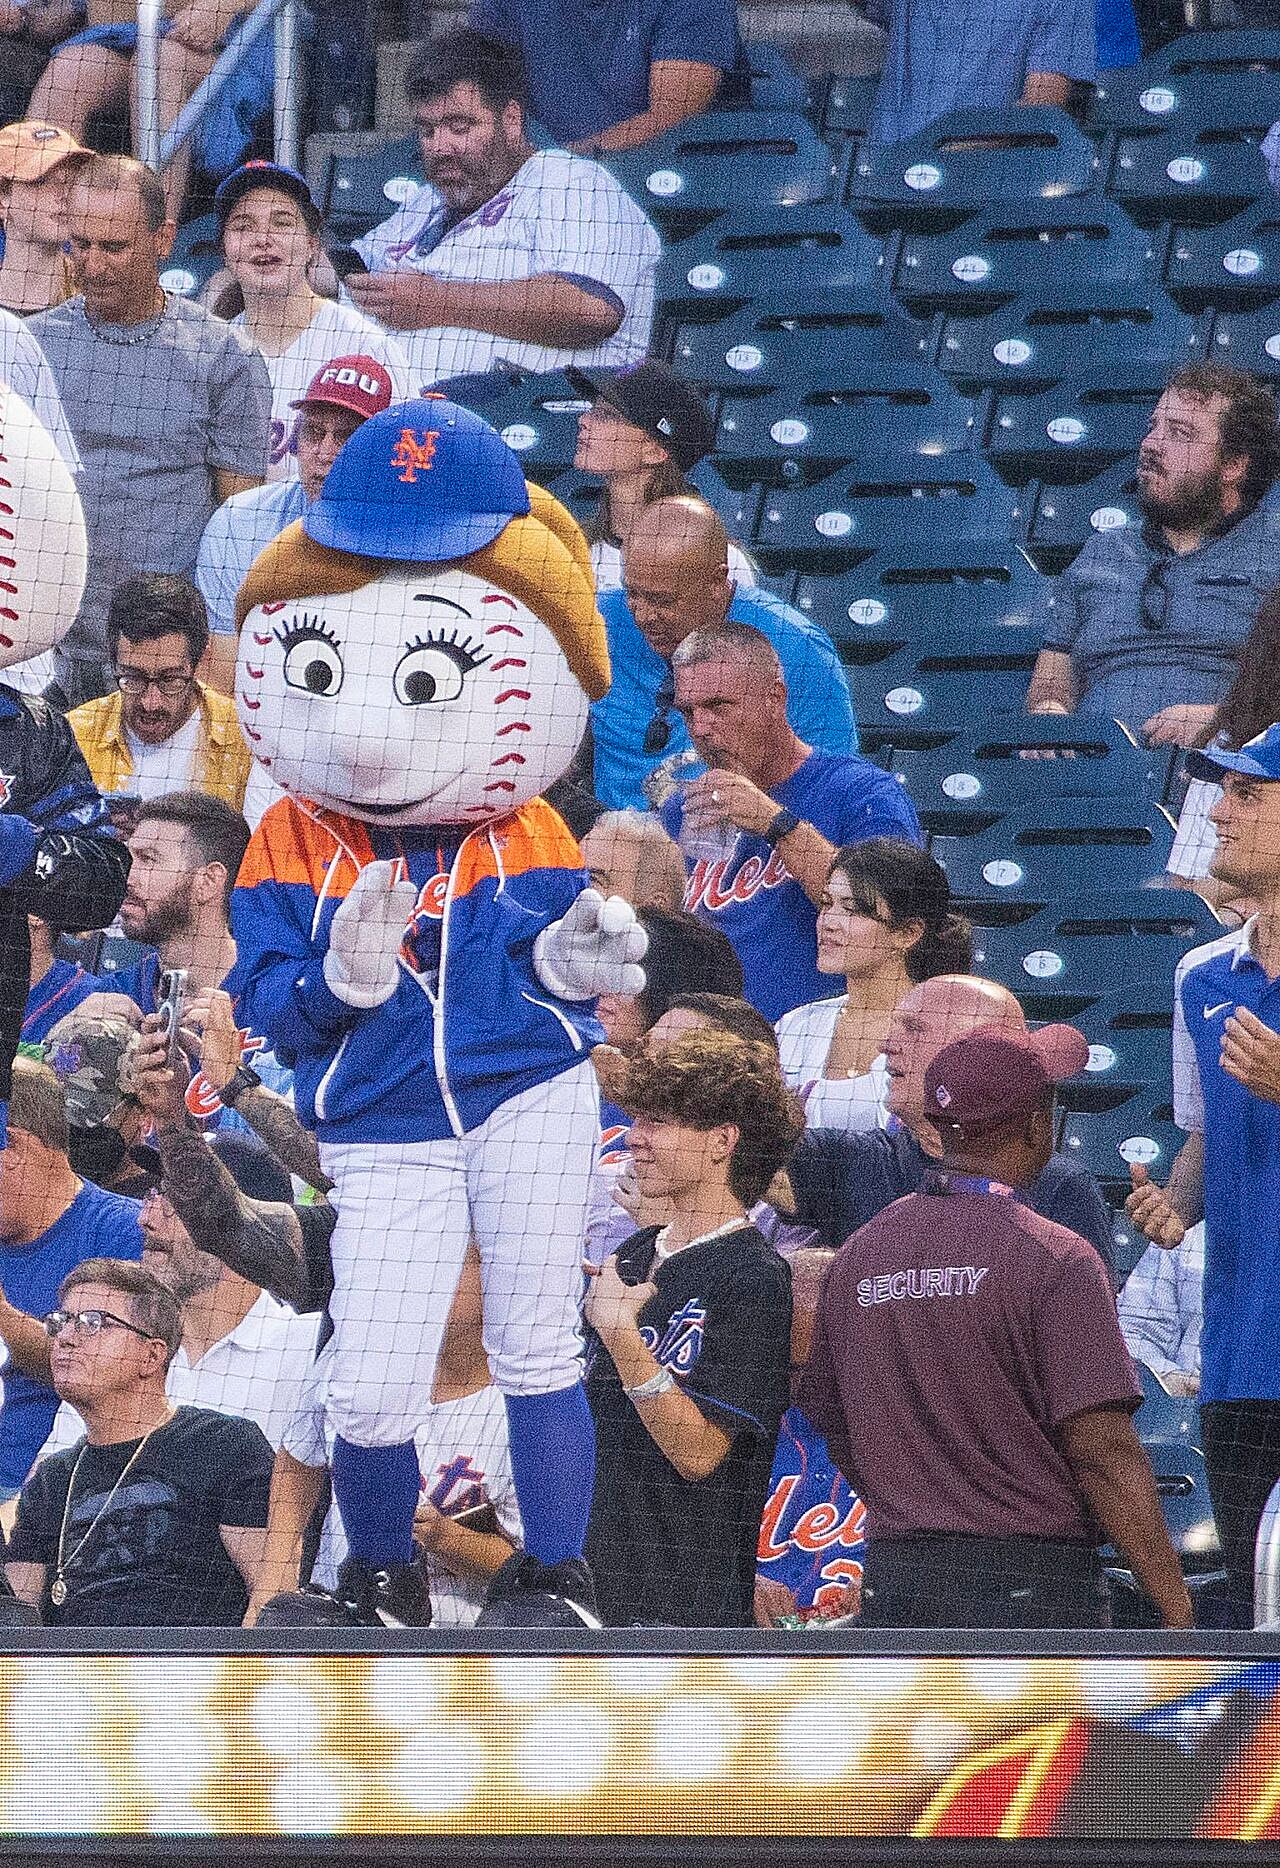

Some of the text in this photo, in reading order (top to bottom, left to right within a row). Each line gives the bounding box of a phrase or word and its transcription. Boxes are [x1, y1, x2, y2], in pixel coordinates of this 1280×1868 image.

[320, 367, 380, 396] FDU
[1102, 514, 1115, 525] 10
[860, 606, 874, 617] 10
[857, 1266, 989, 1307] SECURITY
[638, 1297, 706, 1377] ets
